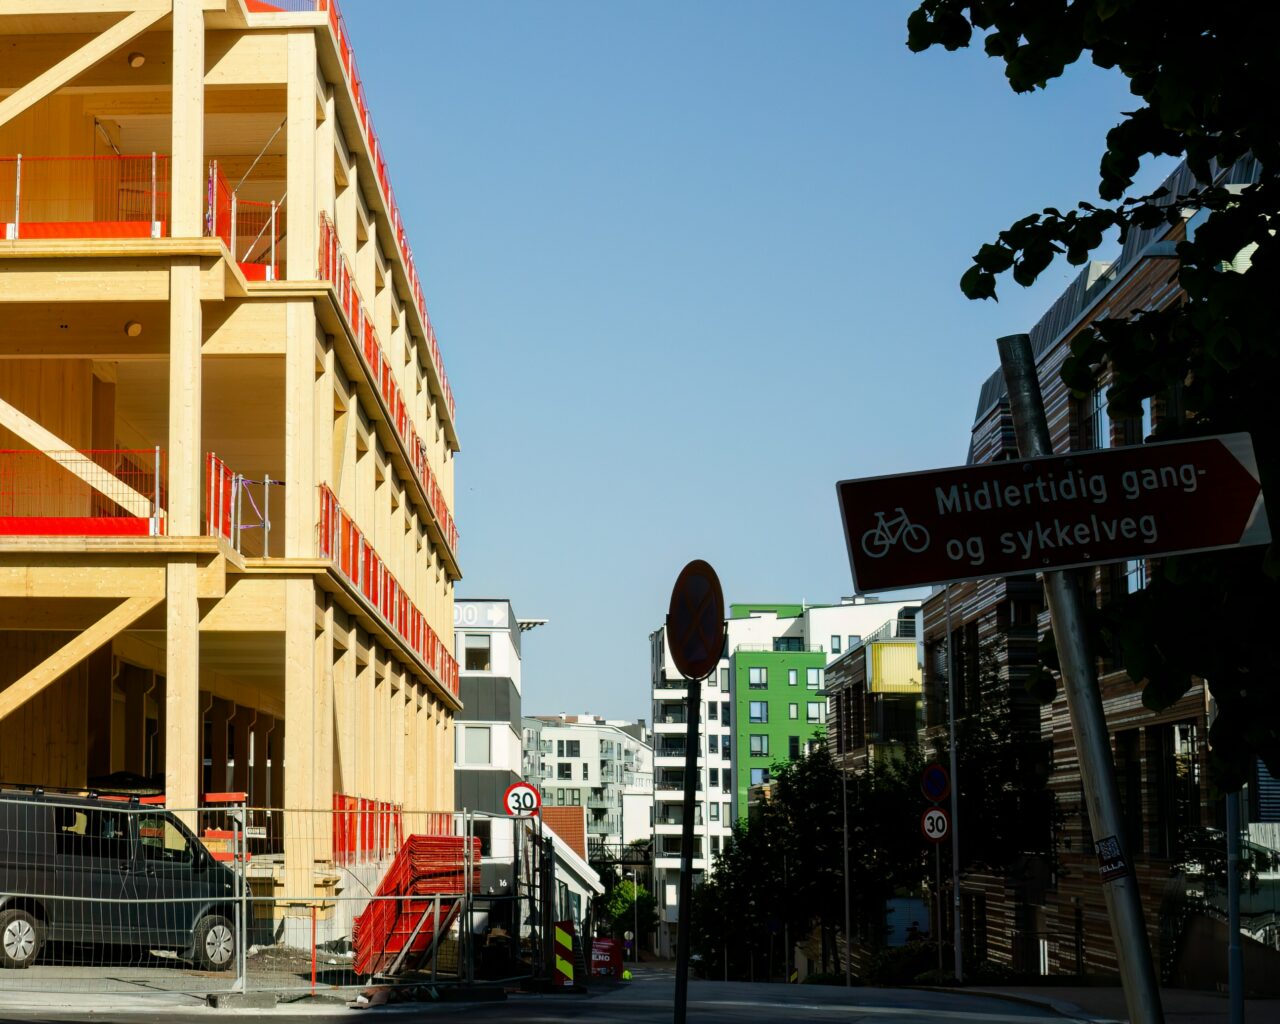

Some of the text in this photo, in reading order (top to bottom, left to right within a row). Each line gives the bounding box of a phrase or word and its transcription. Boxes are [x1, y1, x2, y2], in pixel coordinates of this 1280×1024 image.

[934, 464, 1207, 515] Midlertidig gang-
[946, 514, 1158, 566] og sykkelveg
[511, 792, 534, 810] 30
[926, 815, 946, 833] 30
